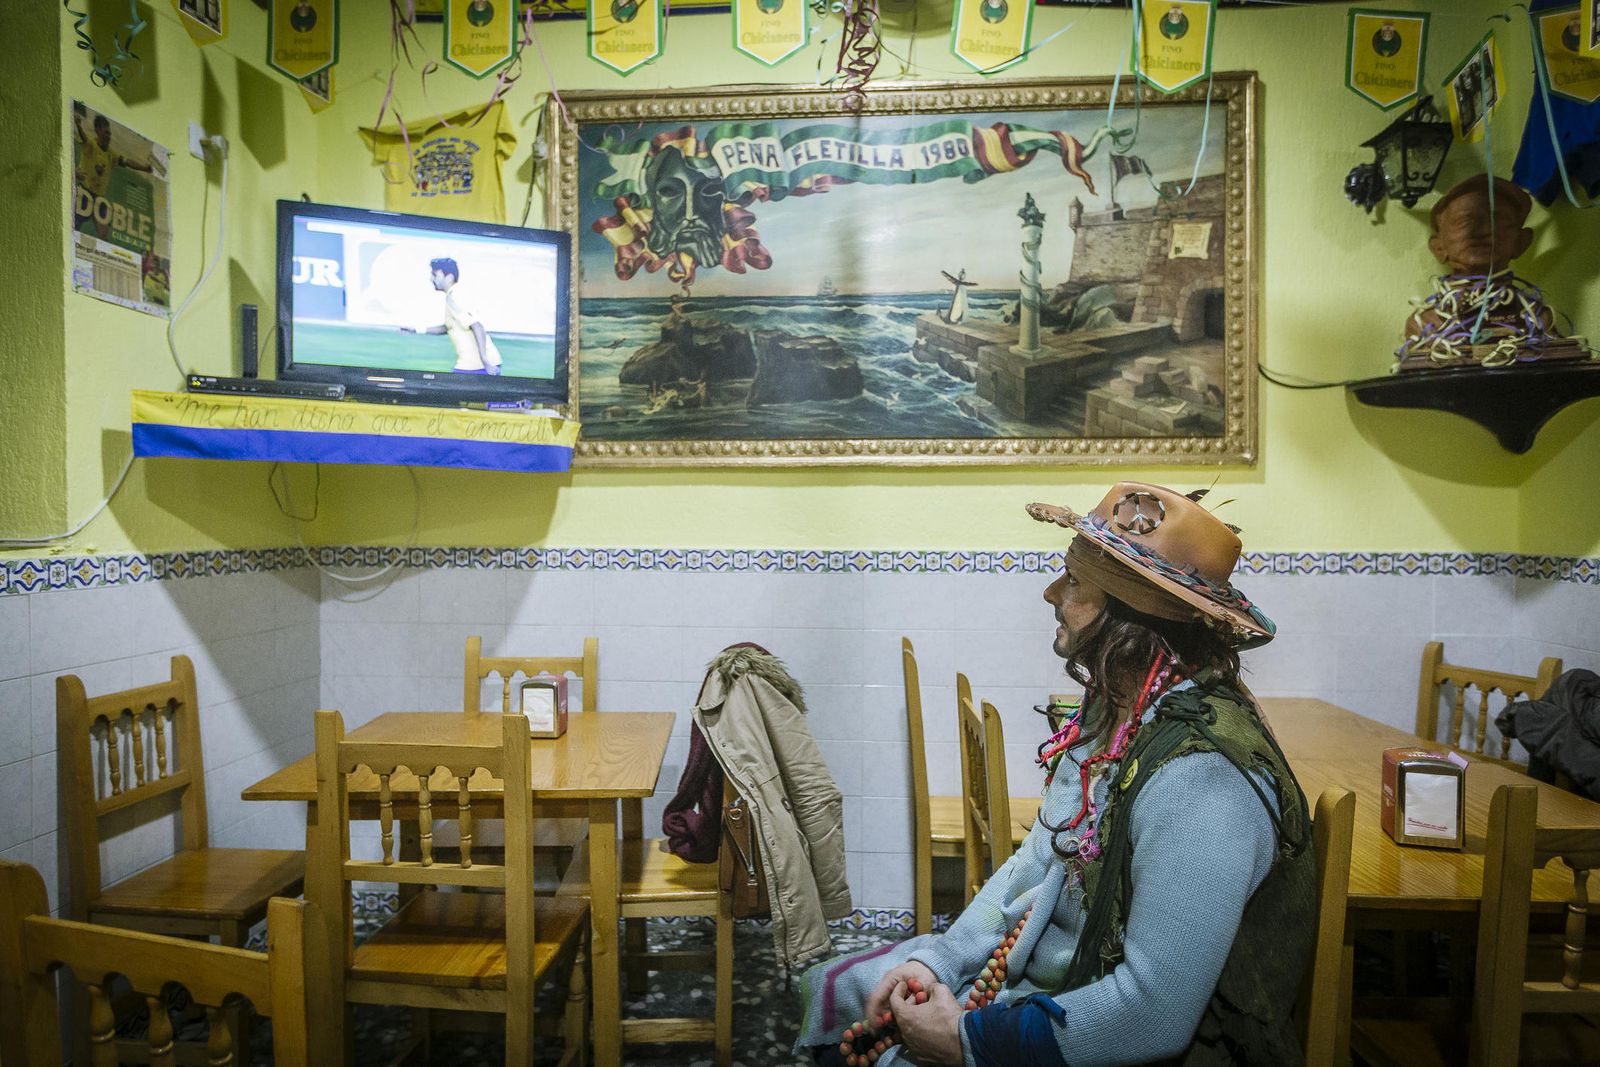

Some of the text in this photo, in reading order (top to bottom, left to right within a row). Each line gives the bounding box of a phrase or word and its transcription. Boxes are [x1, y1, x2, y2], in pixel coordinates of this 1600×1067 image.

[1162, 45, 1182, 53] FINO
[1375, 62, 1397, 71] FINO
[1355, 71, 1414, 88] Chiclanero
[920, 138, 970, 167] 1980
[75, 186, 152, 242] DOBLE
[371, 414, 411, 436] que
[427, 411, 445, 435] el
